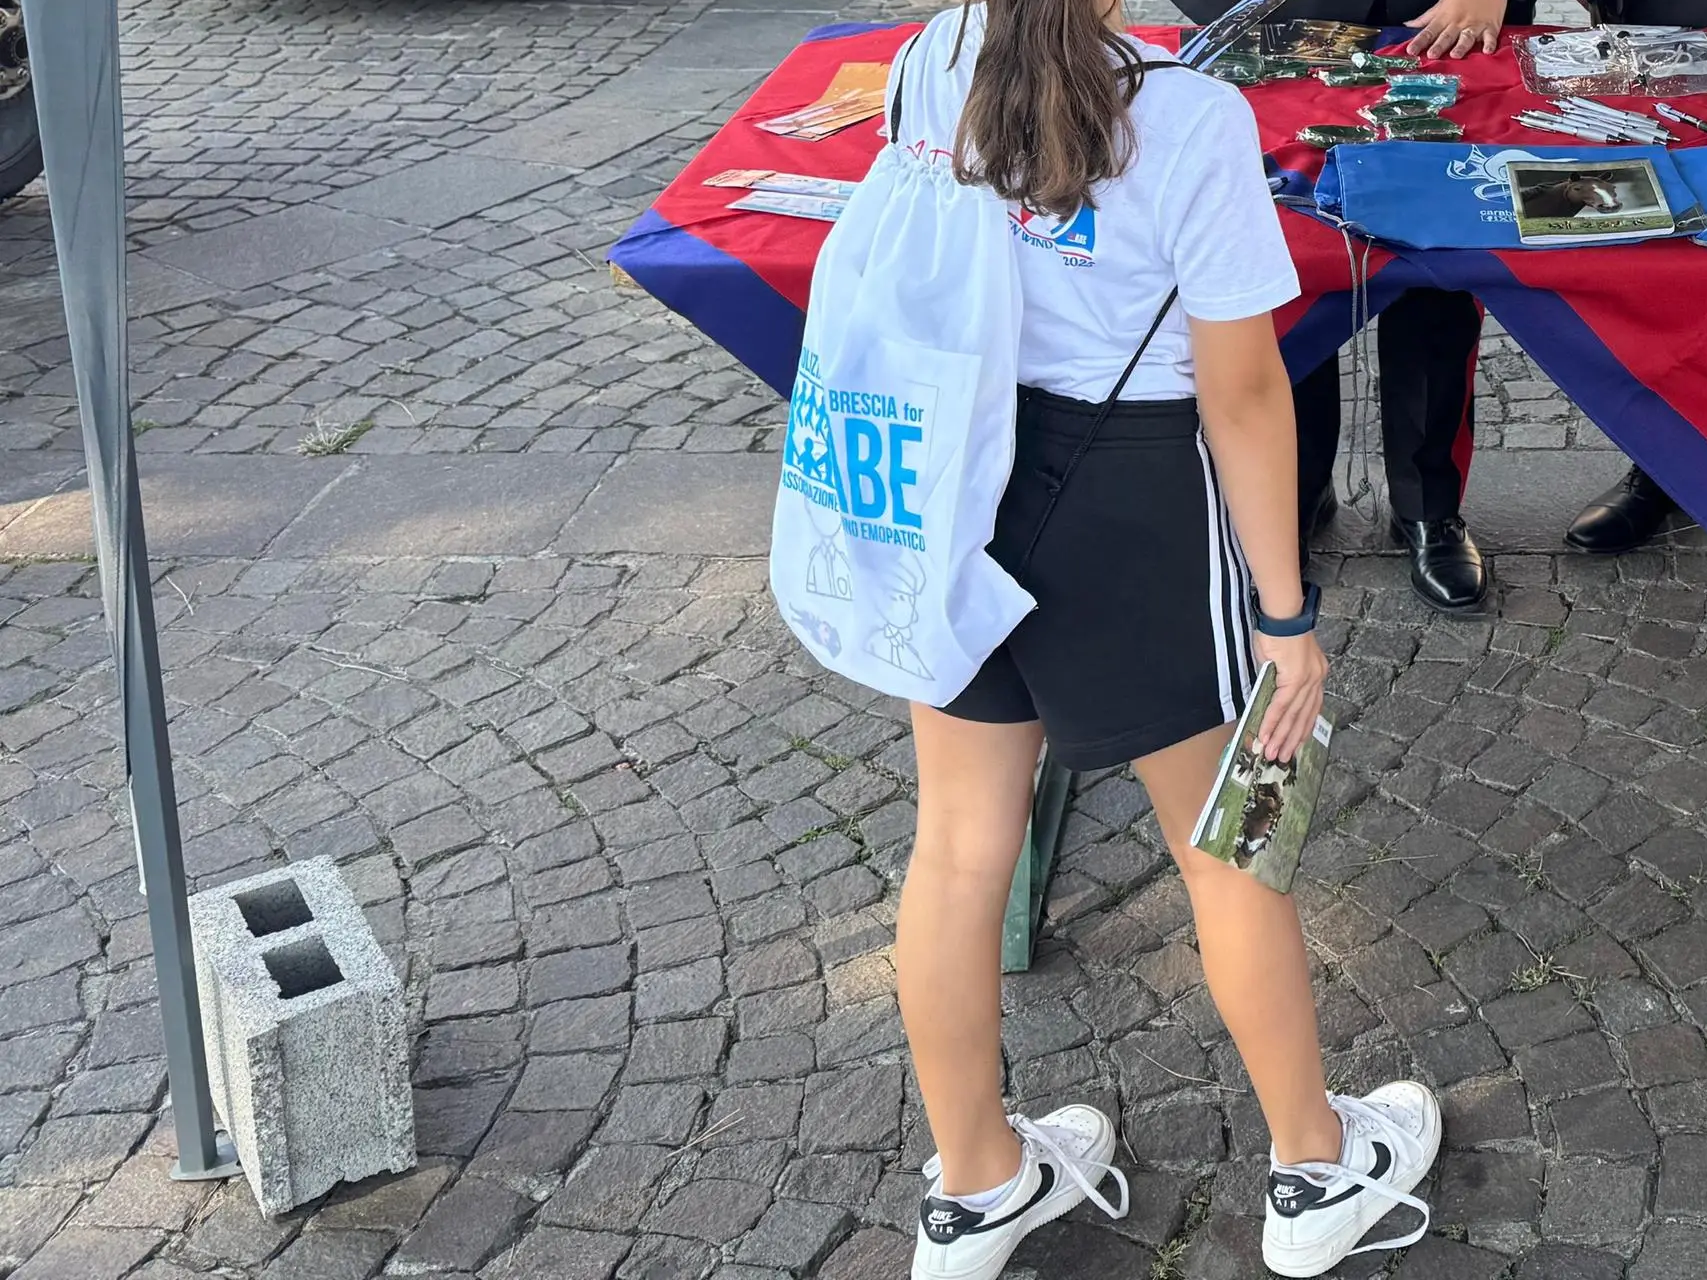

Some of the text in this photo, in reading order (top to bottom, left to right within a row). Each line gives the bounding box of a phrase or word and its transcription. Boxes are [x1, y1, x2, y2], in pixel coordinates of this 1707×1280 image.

[1022, 231, 1053, 249] WIND
[829, 389, 924, 422] BRESCIA for
[860, 524, 926, 553] EMOPATICO
[1276, 1183, 1296, 1195] NIKE
[1275, 1199, 1297, 1209] AIR
[932, 1208, 954, 1221] NIKE
[930, 1224, 954, 1235] AIR
